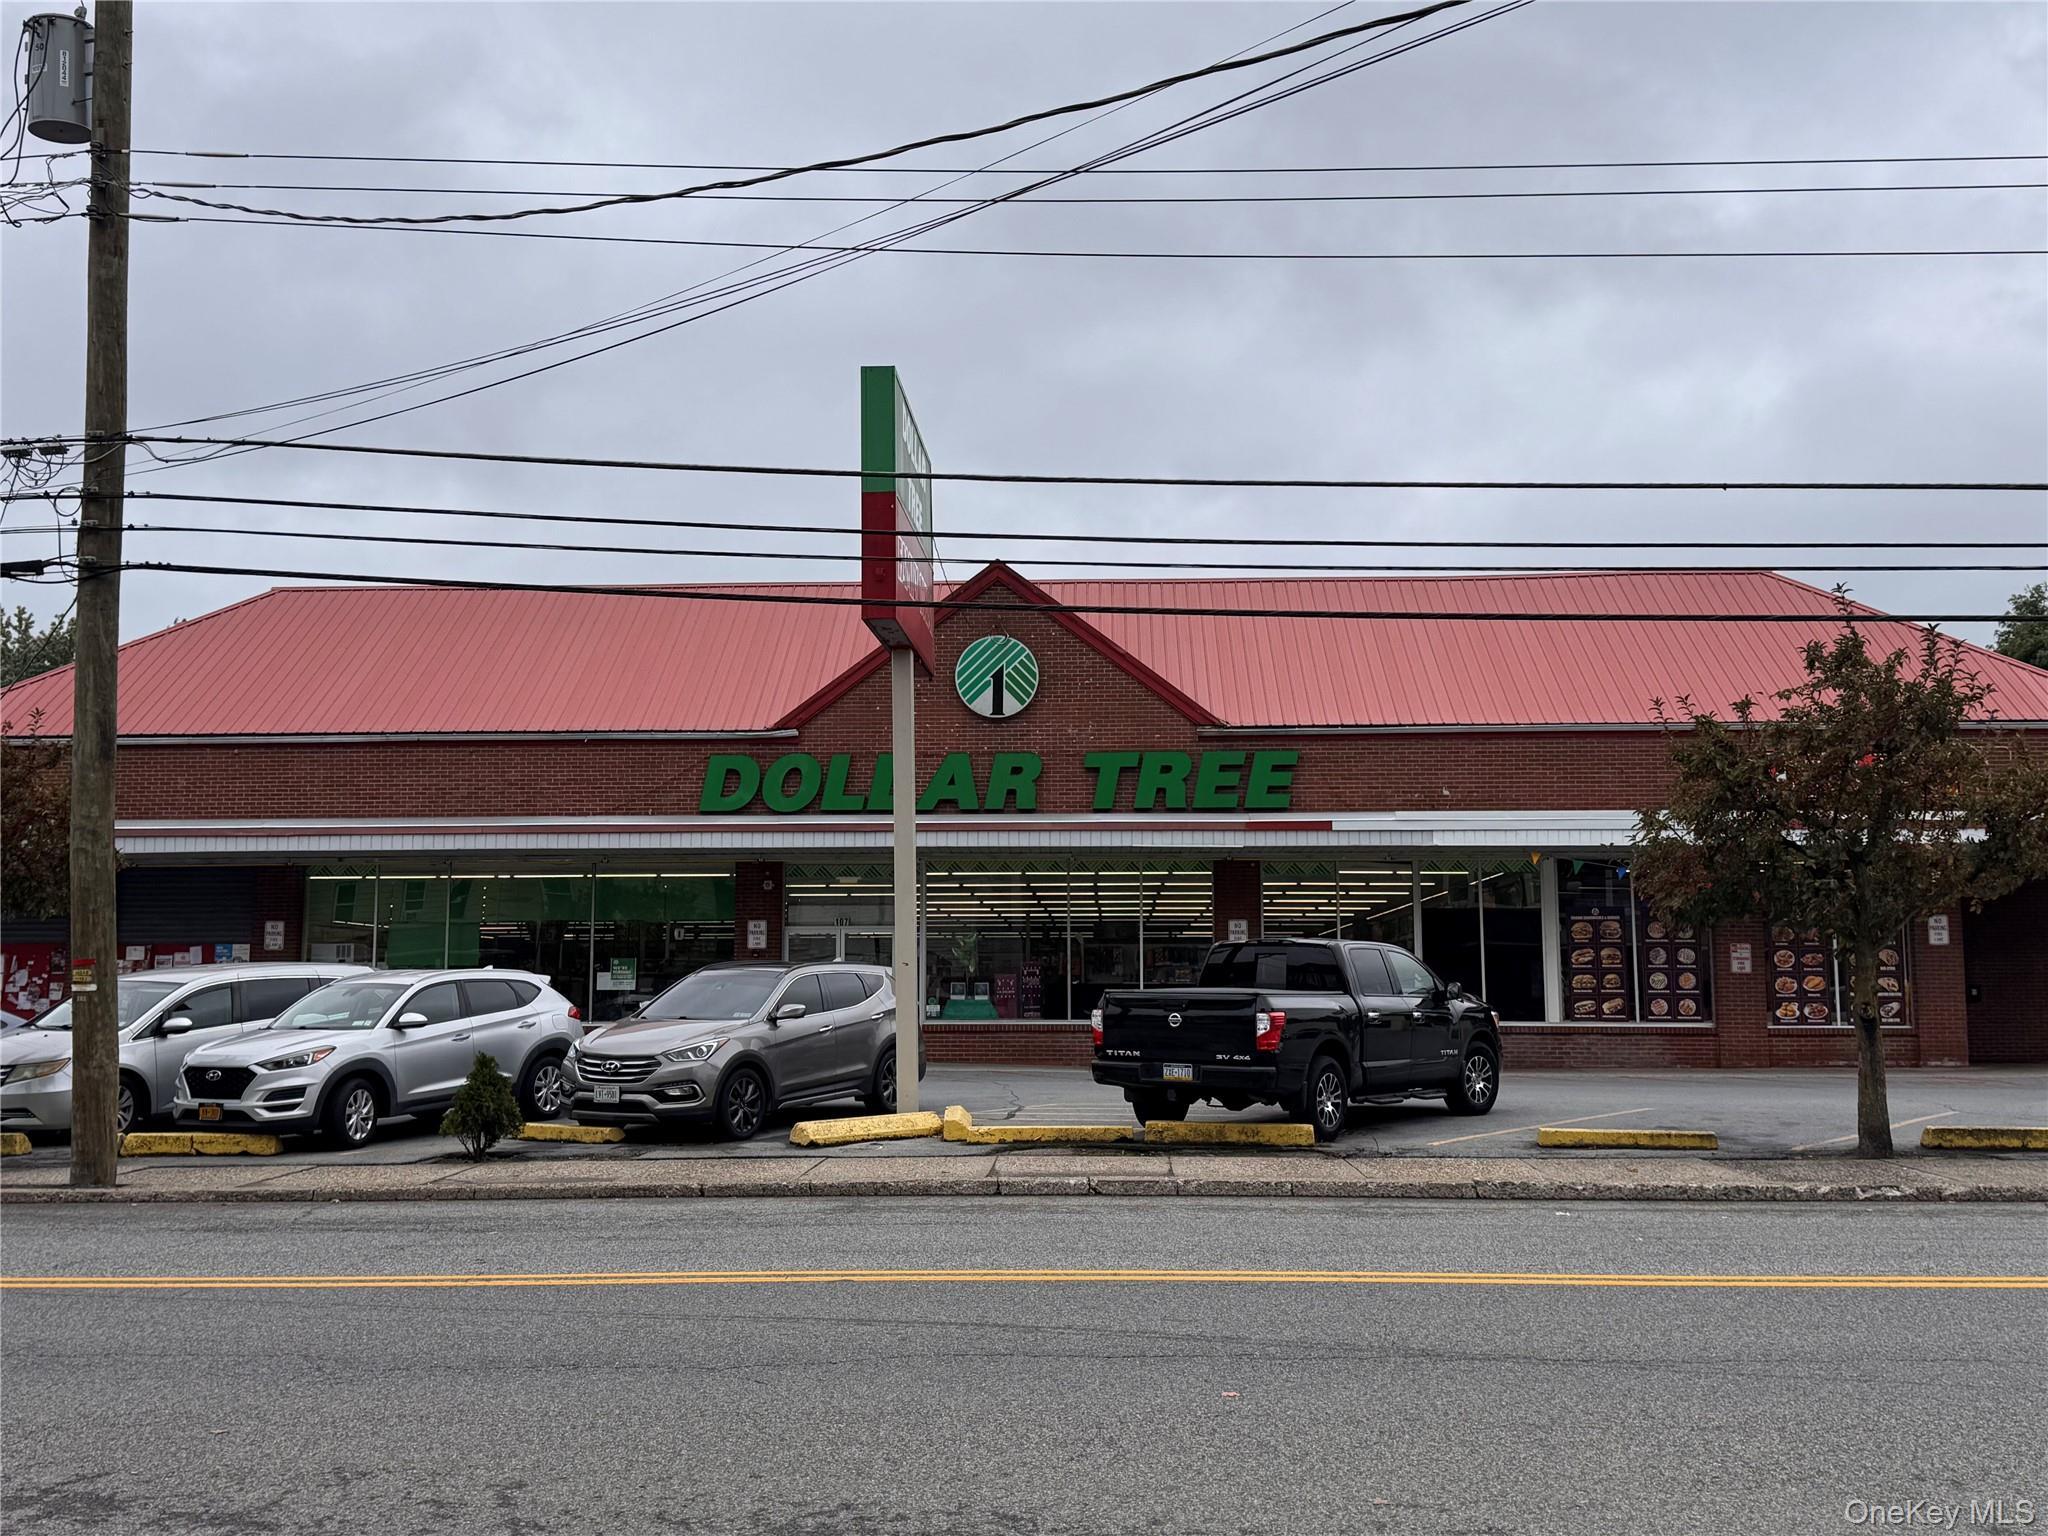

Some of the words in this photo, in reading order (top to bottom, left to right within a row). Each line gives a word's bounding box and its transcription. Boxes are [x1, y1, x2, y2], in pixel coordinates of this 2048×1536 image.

[699, 752, 1043, 813] DOLLAR
[1084, 751, 1300, 810] TREE
[1106, 1049, 1141, 1057] TITAN
